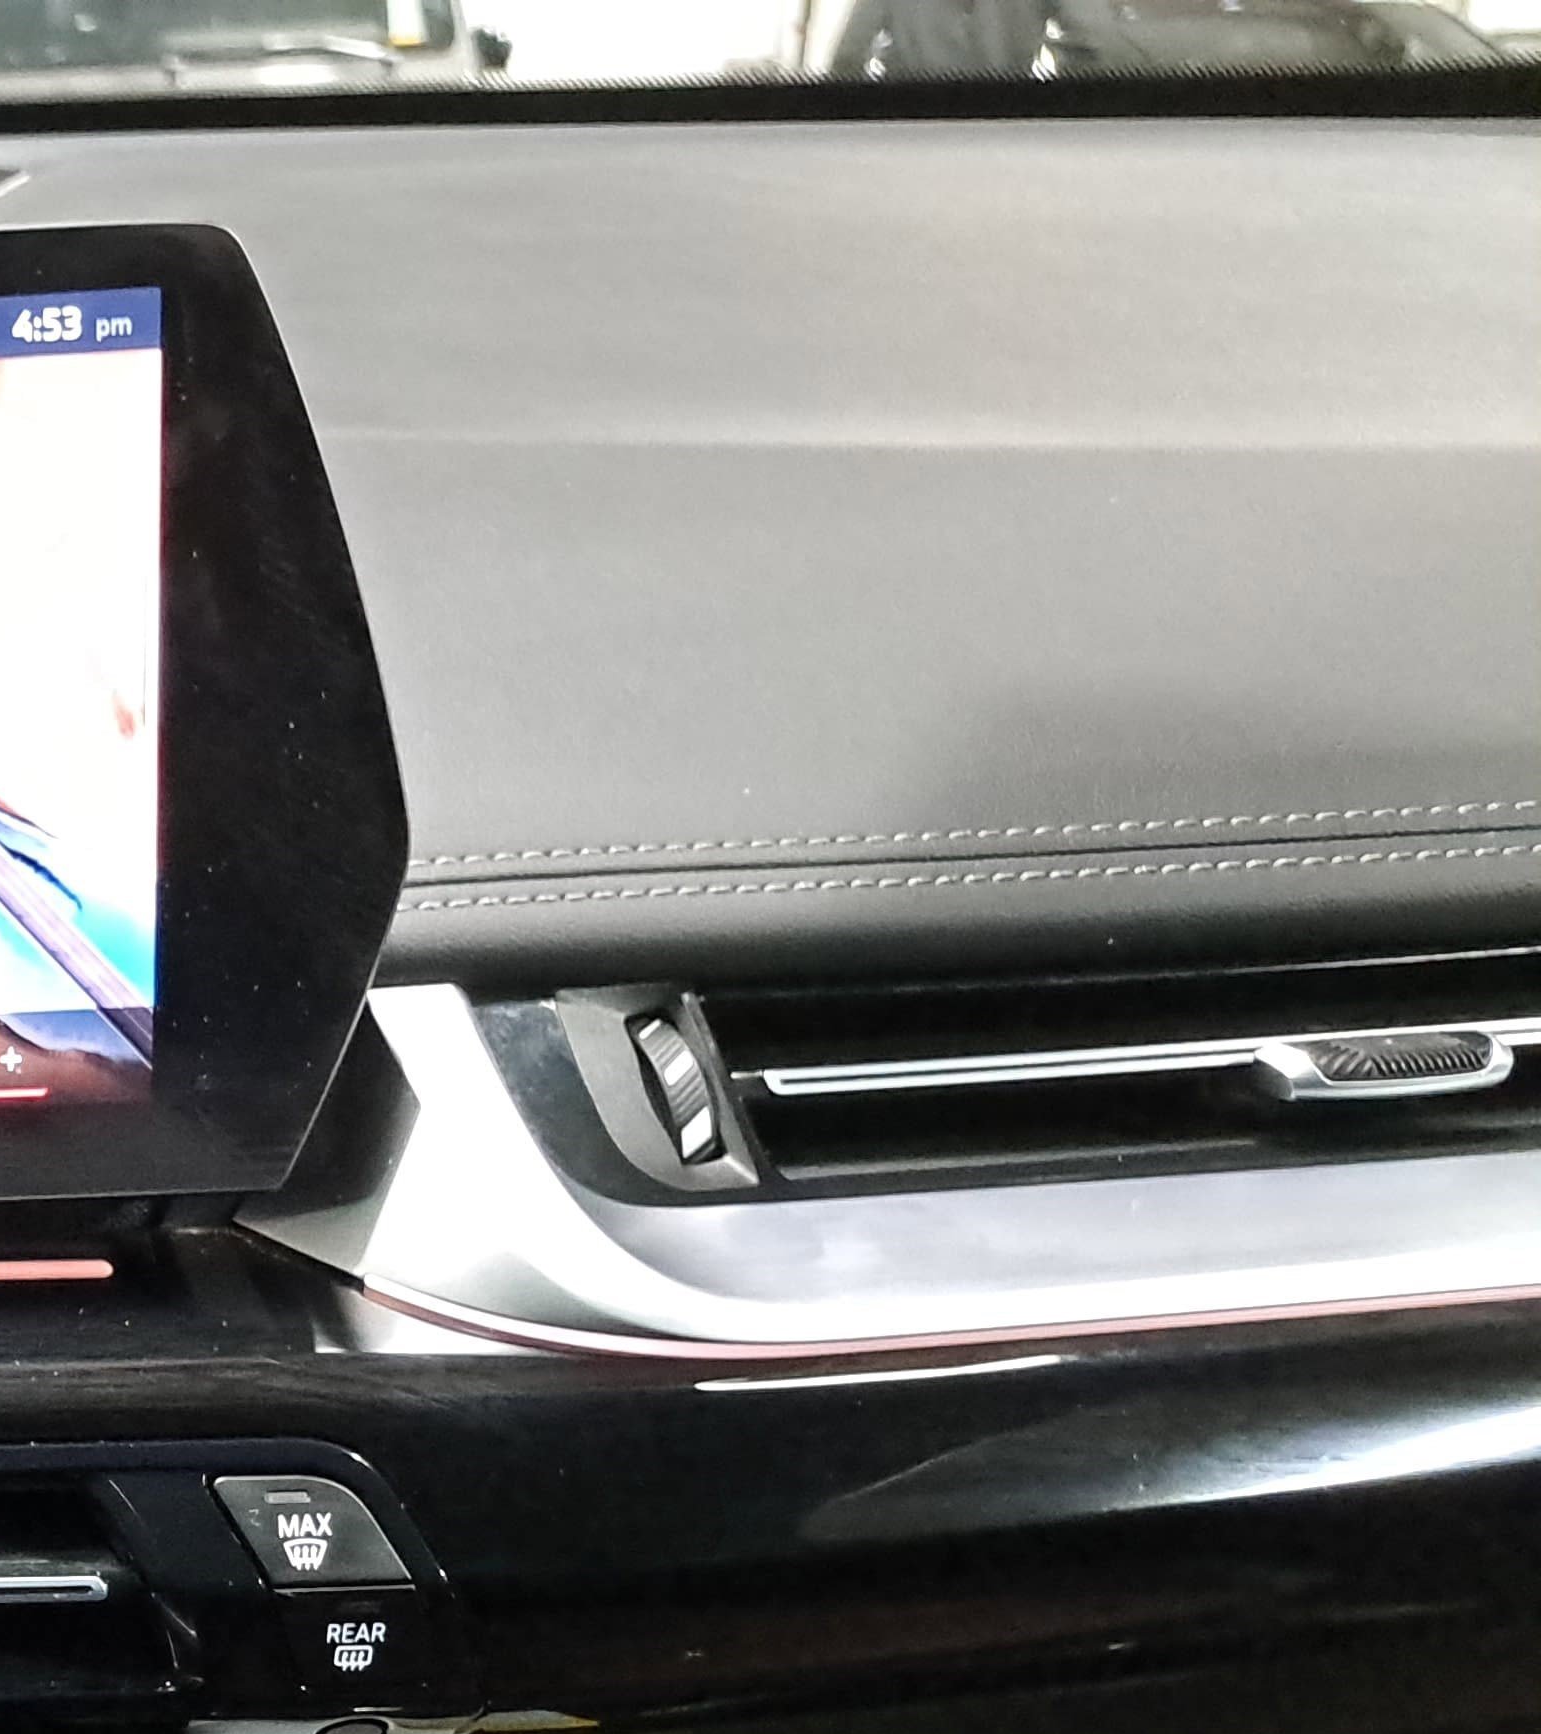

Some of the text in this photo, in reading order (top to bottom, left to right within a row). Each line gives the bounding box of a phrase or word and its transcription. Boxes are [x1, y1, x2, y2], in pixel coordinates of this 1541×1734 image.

[12, 305, 133, 343] 4:53 pm
[277, 1512, 333, 1538] MAX
[326, 1622, 386, 1643] REAR
